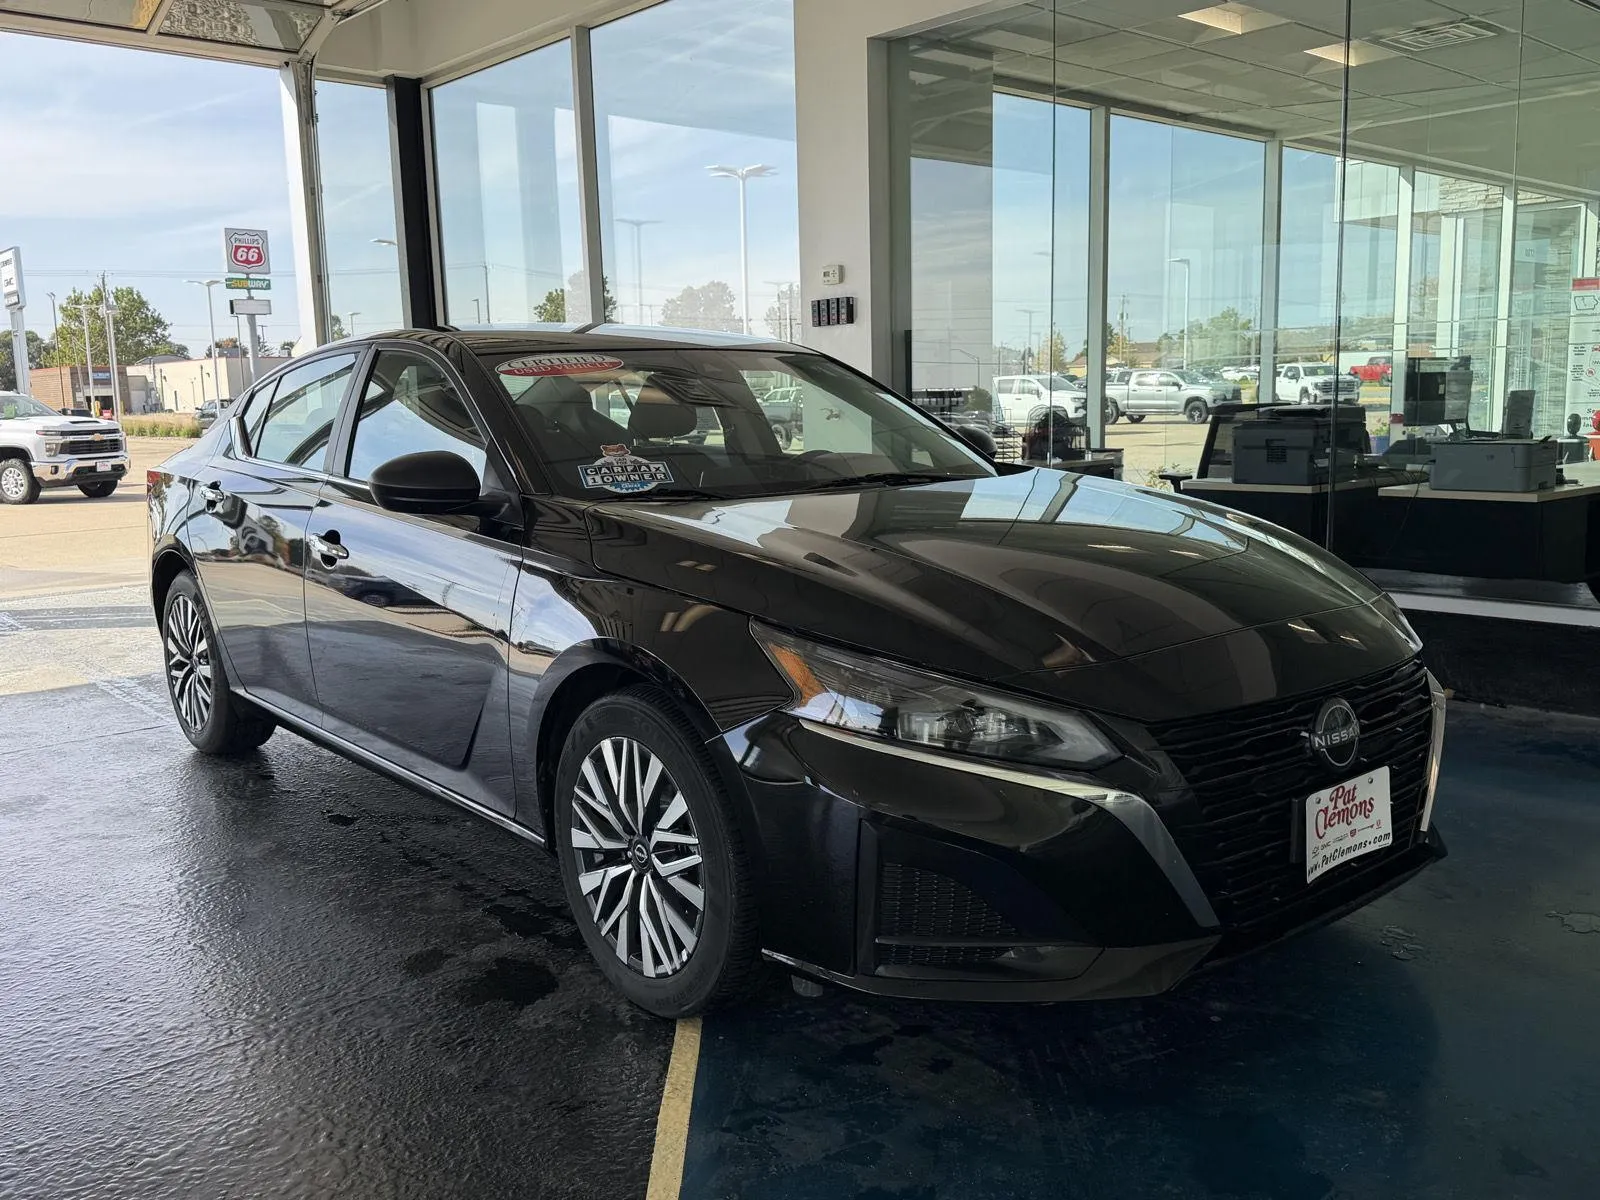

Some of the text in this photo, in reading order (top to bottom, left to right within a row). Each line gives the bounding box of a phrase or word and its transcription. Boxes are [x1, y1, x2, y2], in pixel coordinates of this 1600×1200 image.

[234, 236, 261, 246] PHILLIPS
[236, 247, 259, 262] 66
[231, 280, 269, 288] SUBWAY
[508, 355, 606, 368] CERTIFIED
[514, 361, 613, 375] USED VEHICLE
[586, 465, 663, 476] CARFAX
[590, 472, 667, 484] 1 OWNER
[1314, 724, 1361, 748] NISSAN
[1329, 783, 1358, 811] Pat
[1315, 796, 1375, 840] Clemons
[1308, 832, 1391, 877] www.PatClemons.com
